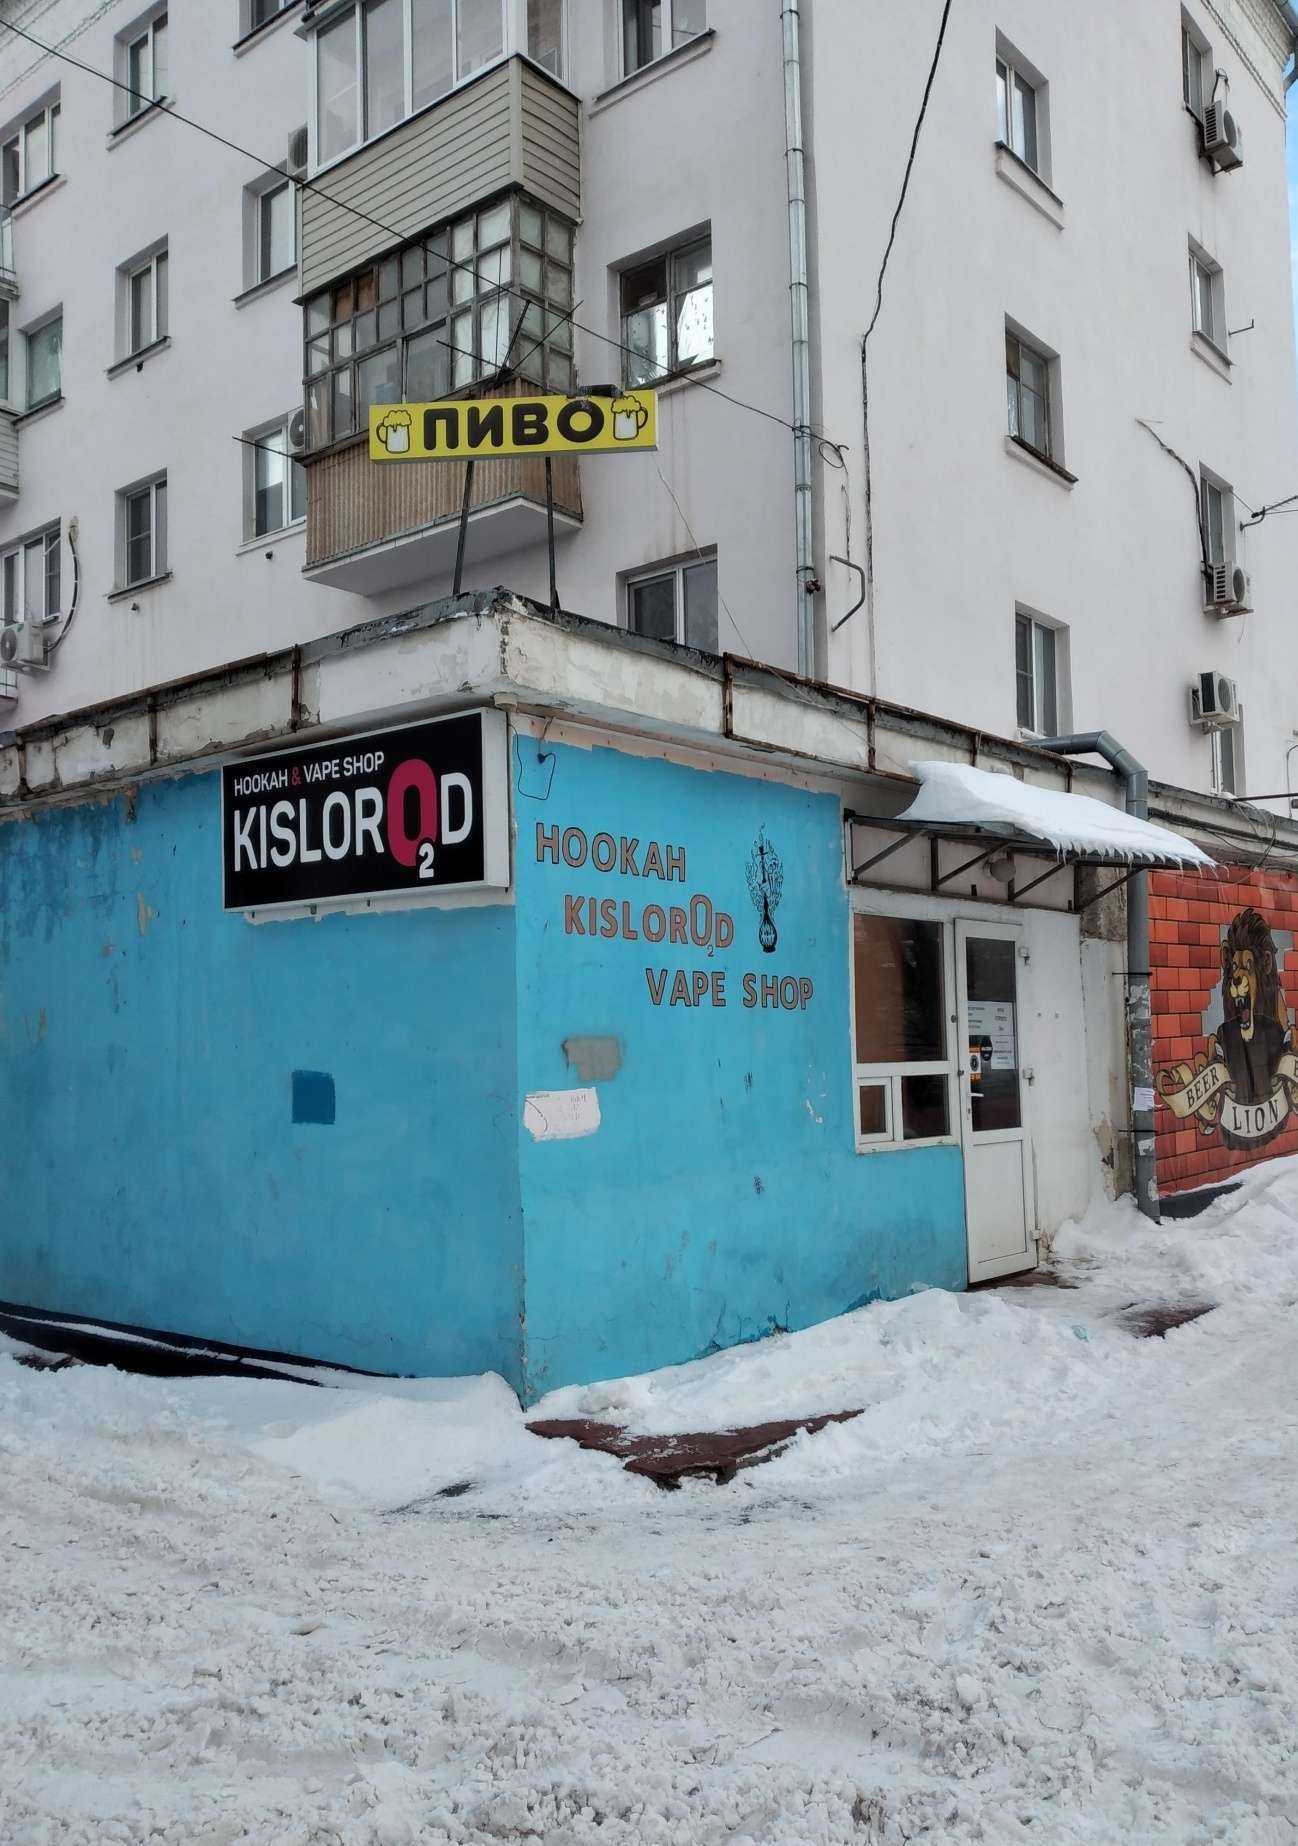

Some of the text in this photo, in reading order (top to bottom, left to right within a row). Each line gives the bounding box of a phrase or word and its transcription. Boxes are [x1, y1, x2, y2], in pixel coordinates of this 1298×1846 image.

[423, 399, 605, 450] ПИВО
[234, 751, 385, 797] HOOKAH & VAPE SHOP
[535, 822, 686, 882] HOOKAH
[645, 968, 814, 1010] VAPE SHOP
[1185, 1066, 1220, 1109] BEER
[1232, 1099, 1281, 1132] LION
